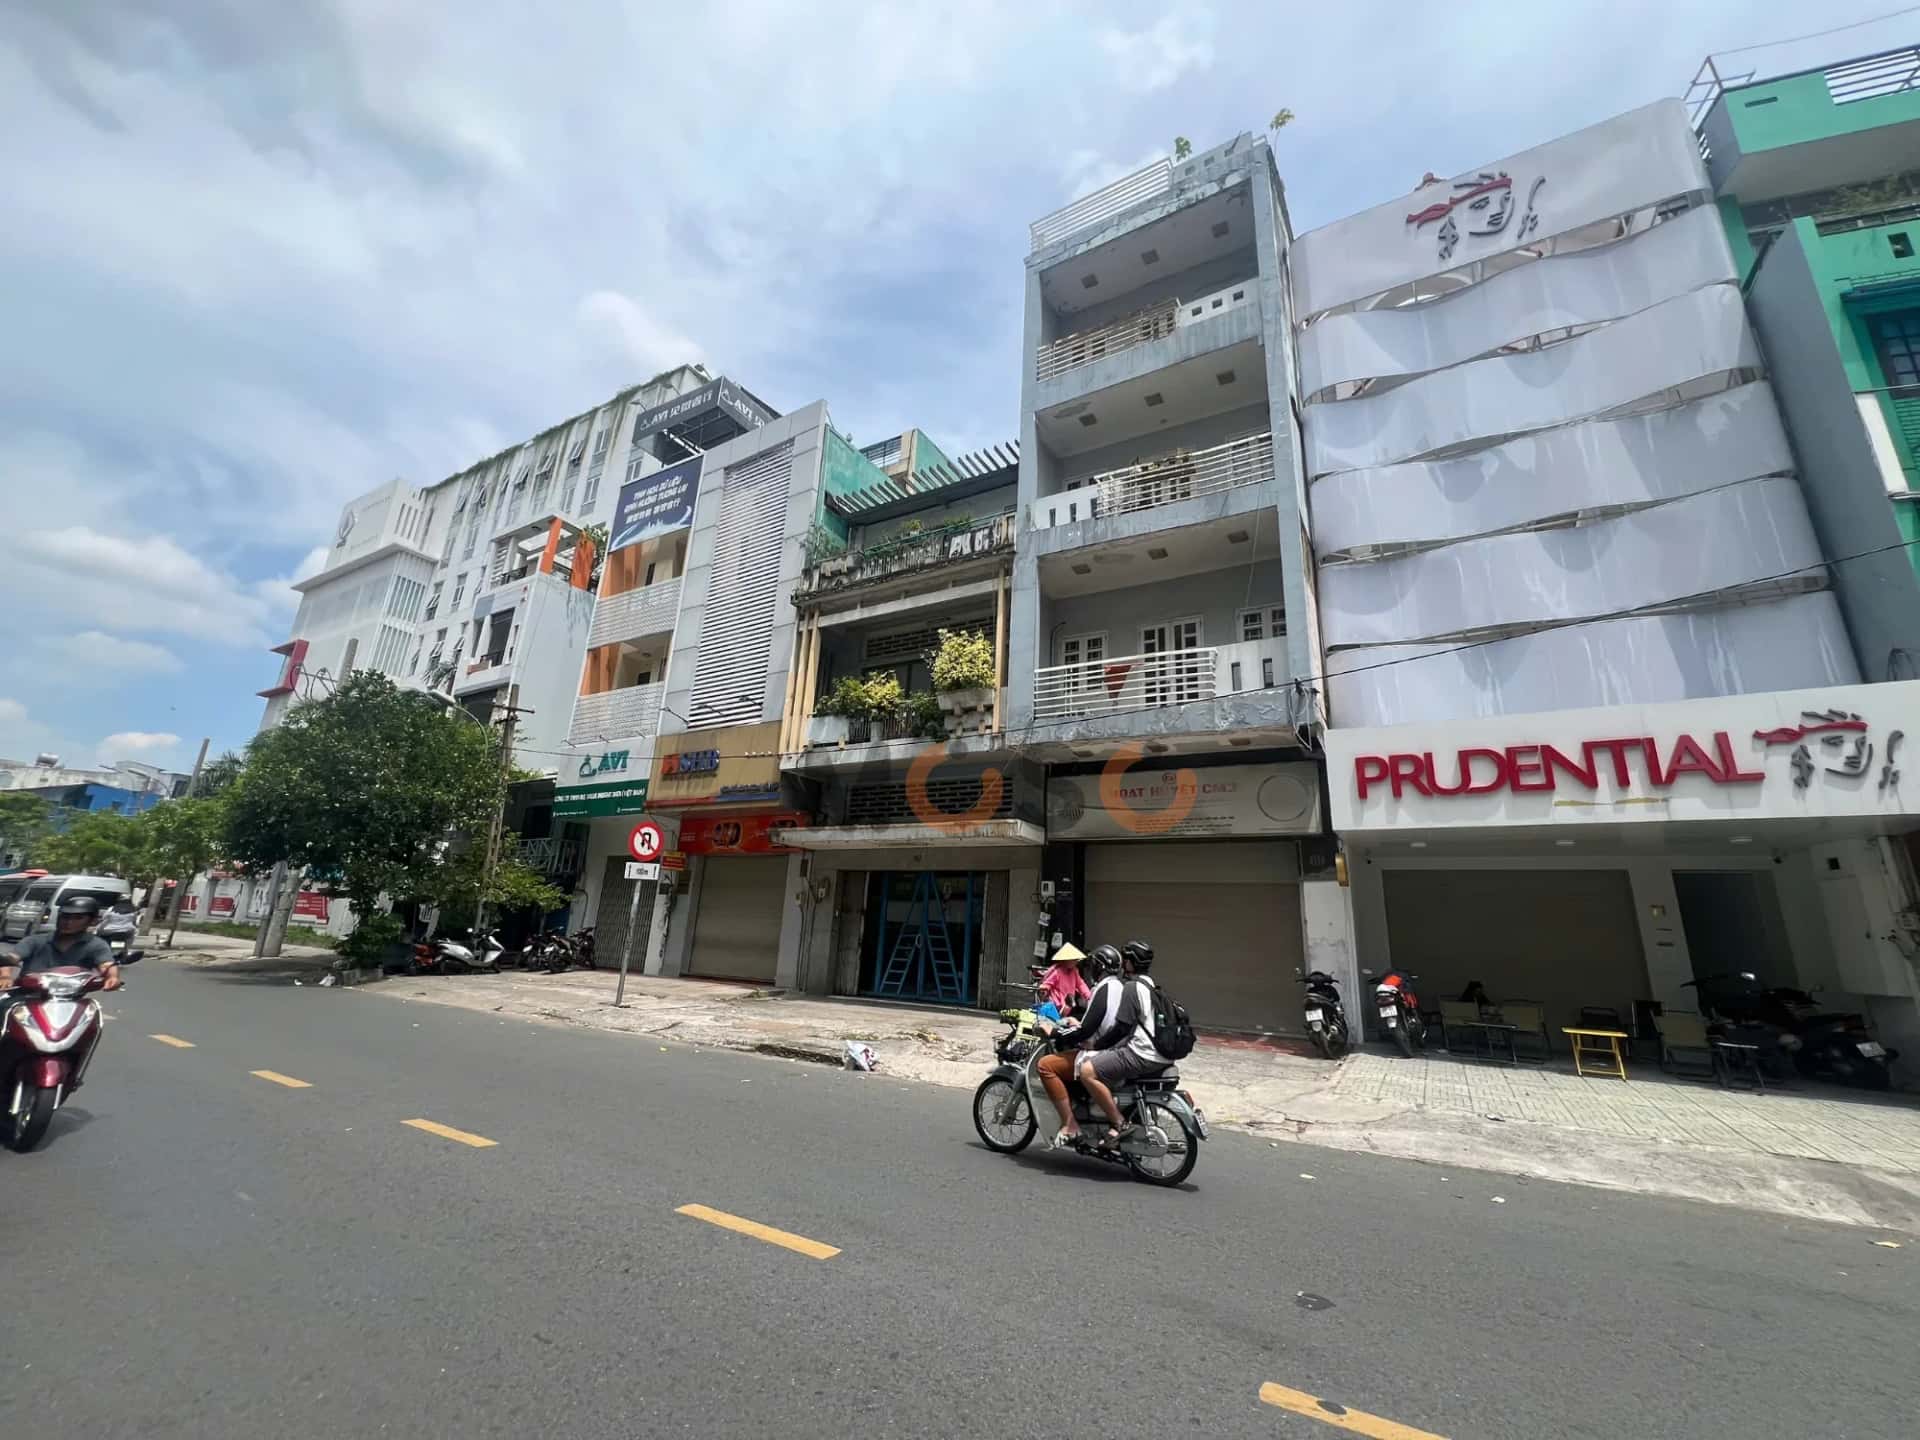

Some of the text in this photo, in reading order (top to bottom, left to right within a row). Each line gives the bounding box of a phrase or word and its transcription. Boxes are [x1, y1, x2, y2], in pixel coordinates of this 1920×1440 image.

[732, 399, 753, 422] AVI
[598, 750, 631, 772] AVI
[1354, 732, 1766, 800] PRUDENTIAL
